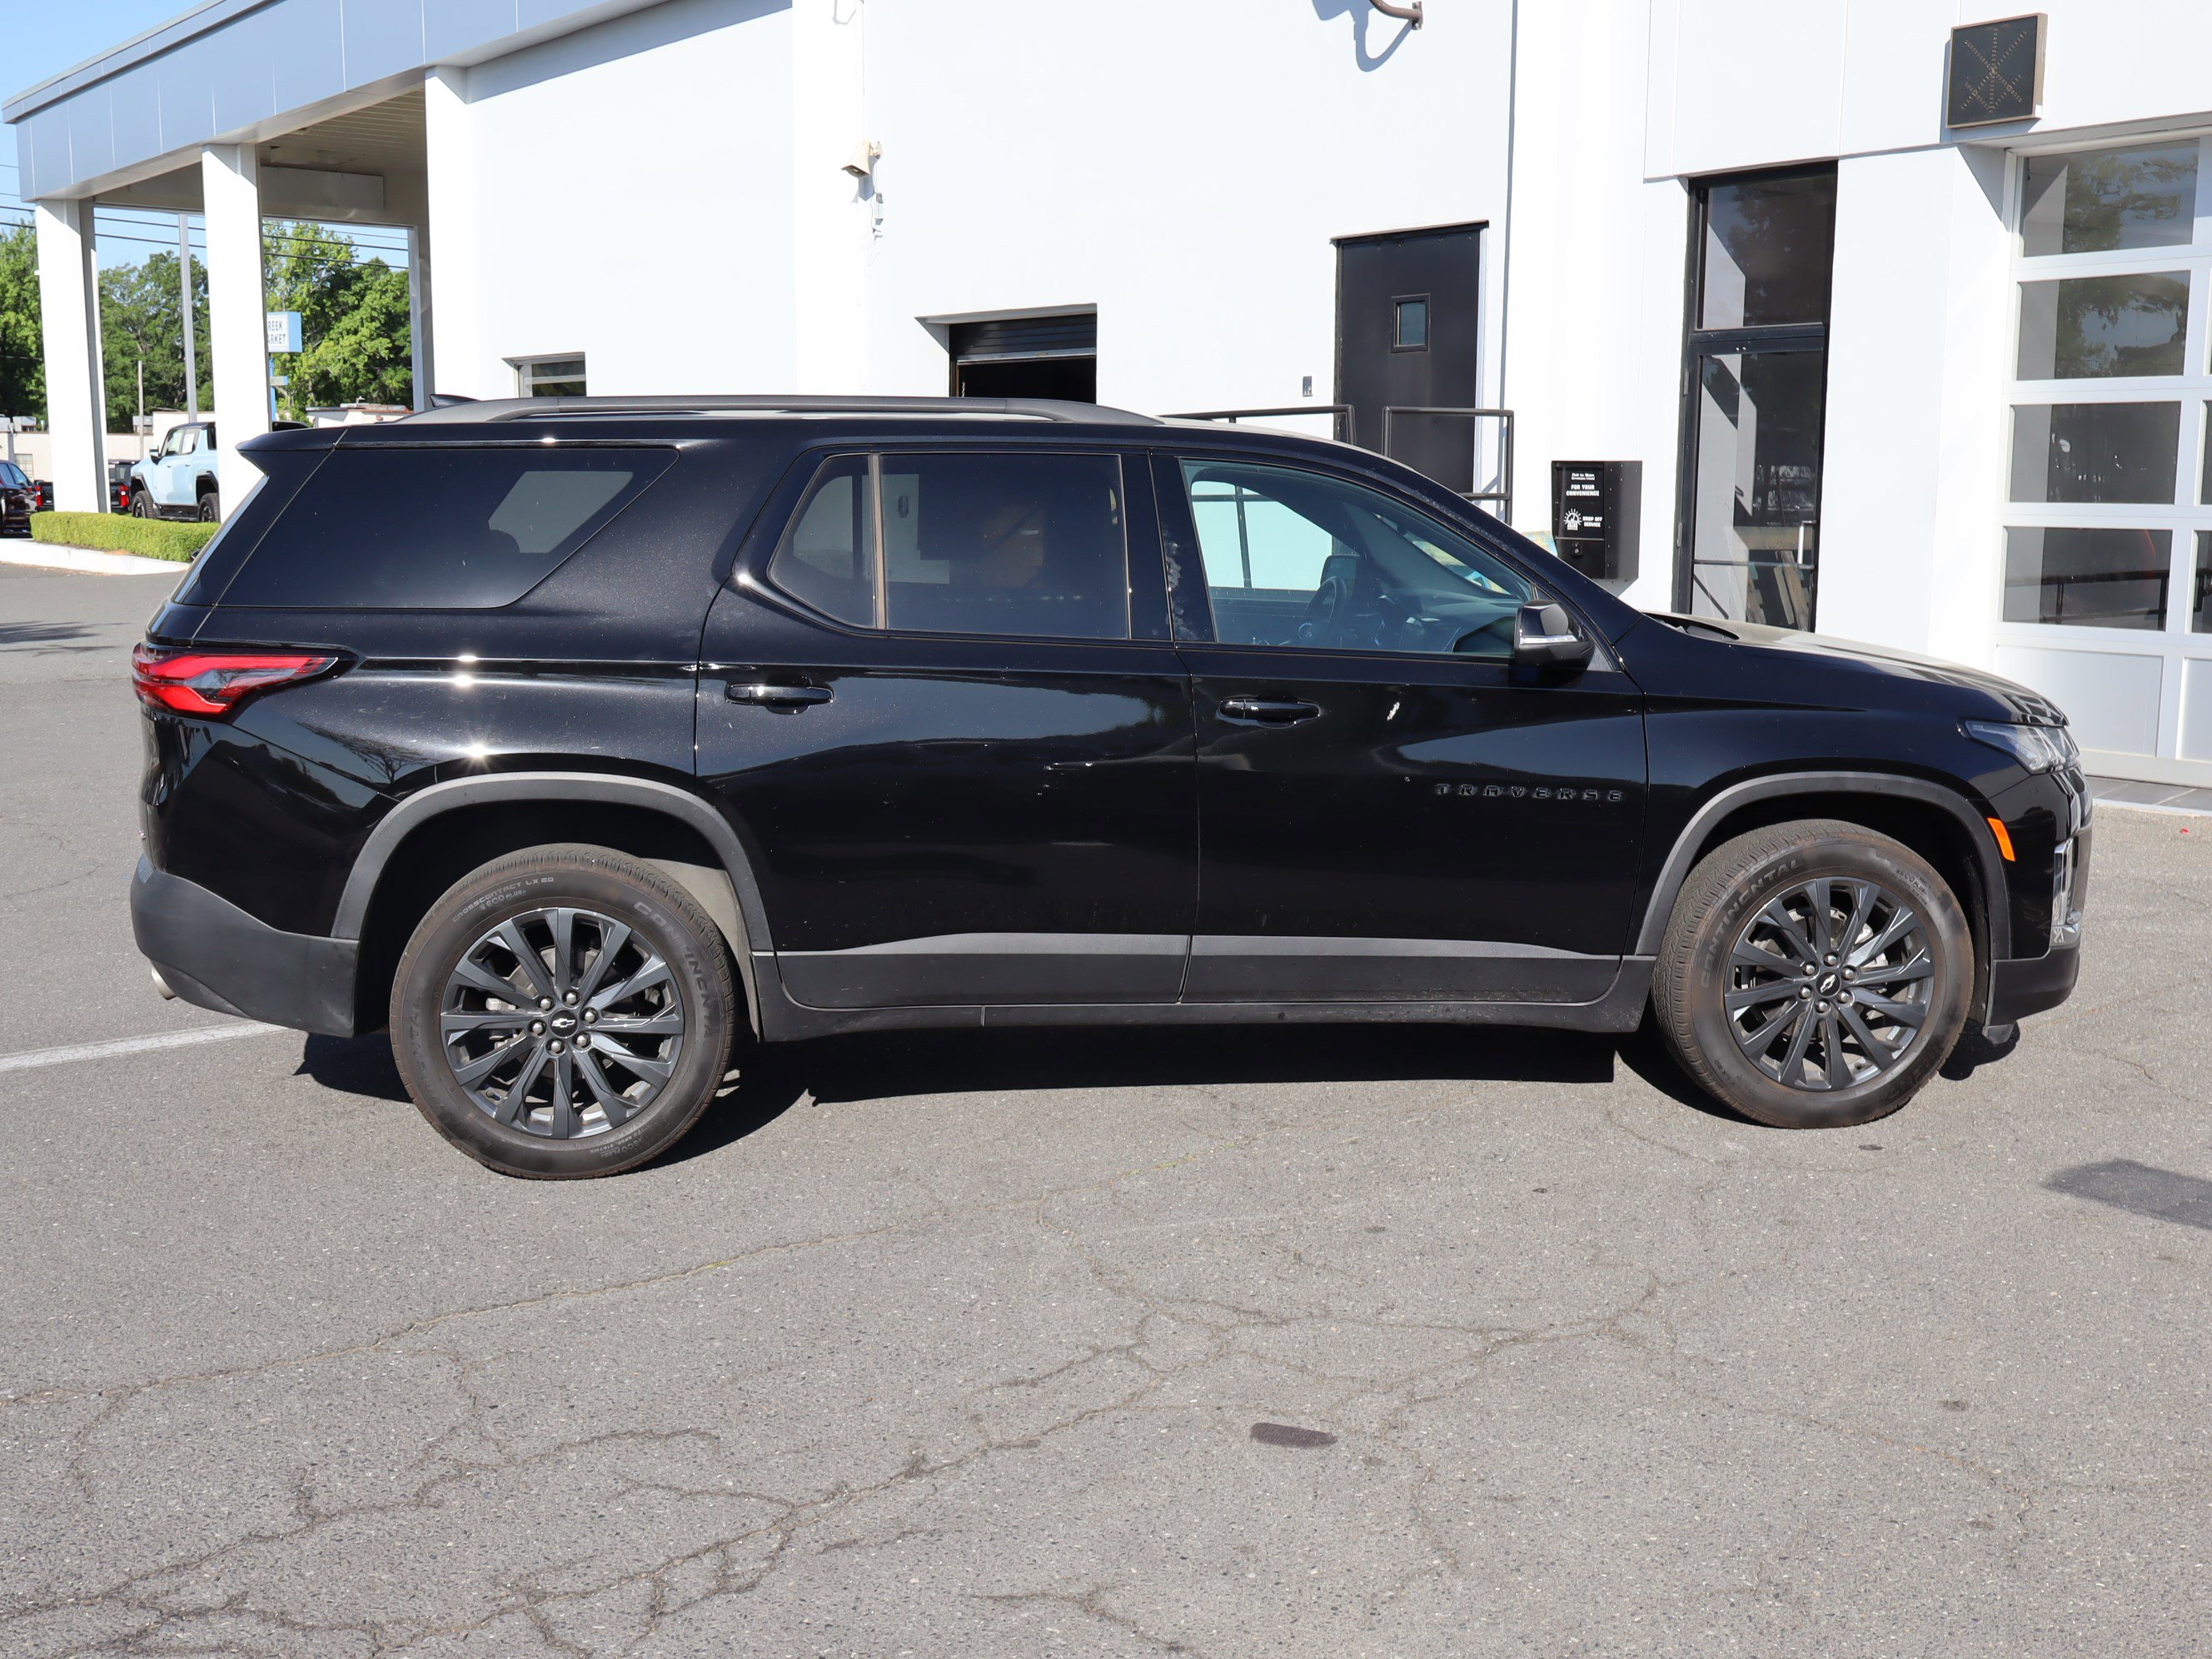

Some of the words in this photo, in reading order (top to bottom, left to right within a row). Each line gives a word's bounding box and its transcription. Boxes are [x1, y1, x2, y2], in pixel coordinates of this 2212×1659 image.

[267, 321, 283, 331] REEK
[267, 333, 286, 345] ARKET
[1436, 783, 1624, 802] TRAVERSE
[452, 881, 522, 923] CROSSCONTACT
[1701, 859, 1800, 988] CONTINENTAL
